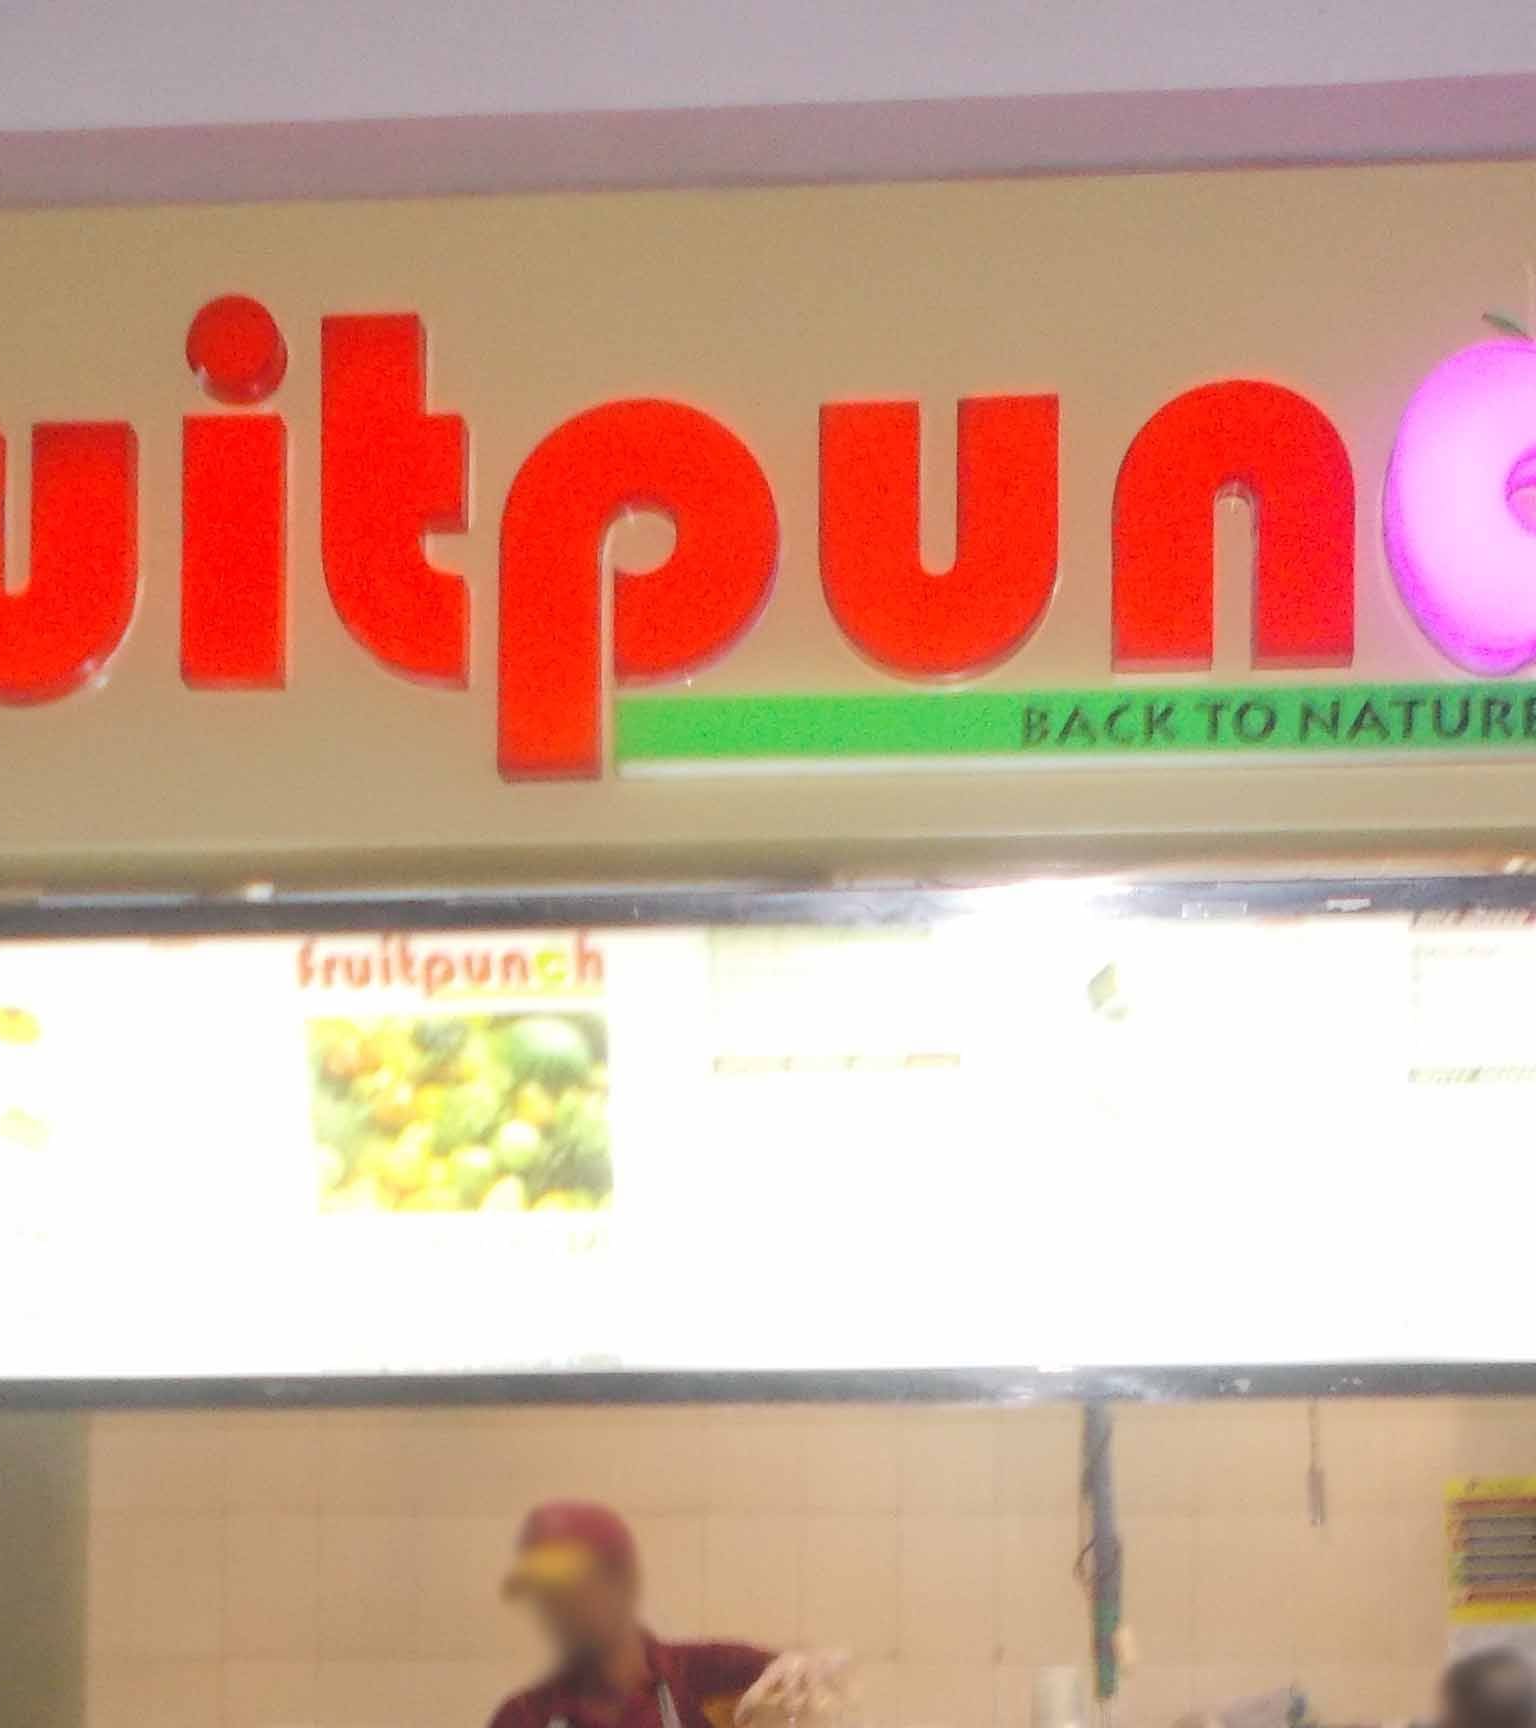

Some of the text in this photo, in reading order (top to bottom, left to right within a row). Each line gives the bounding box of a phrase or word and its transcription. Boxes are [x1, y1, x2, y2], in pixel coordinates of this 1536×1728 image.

[1020, 700, 1175, 746] BACK
[1196, 697, 1277, 743] TO
[296, 929, 605, 999] fruitpunch
